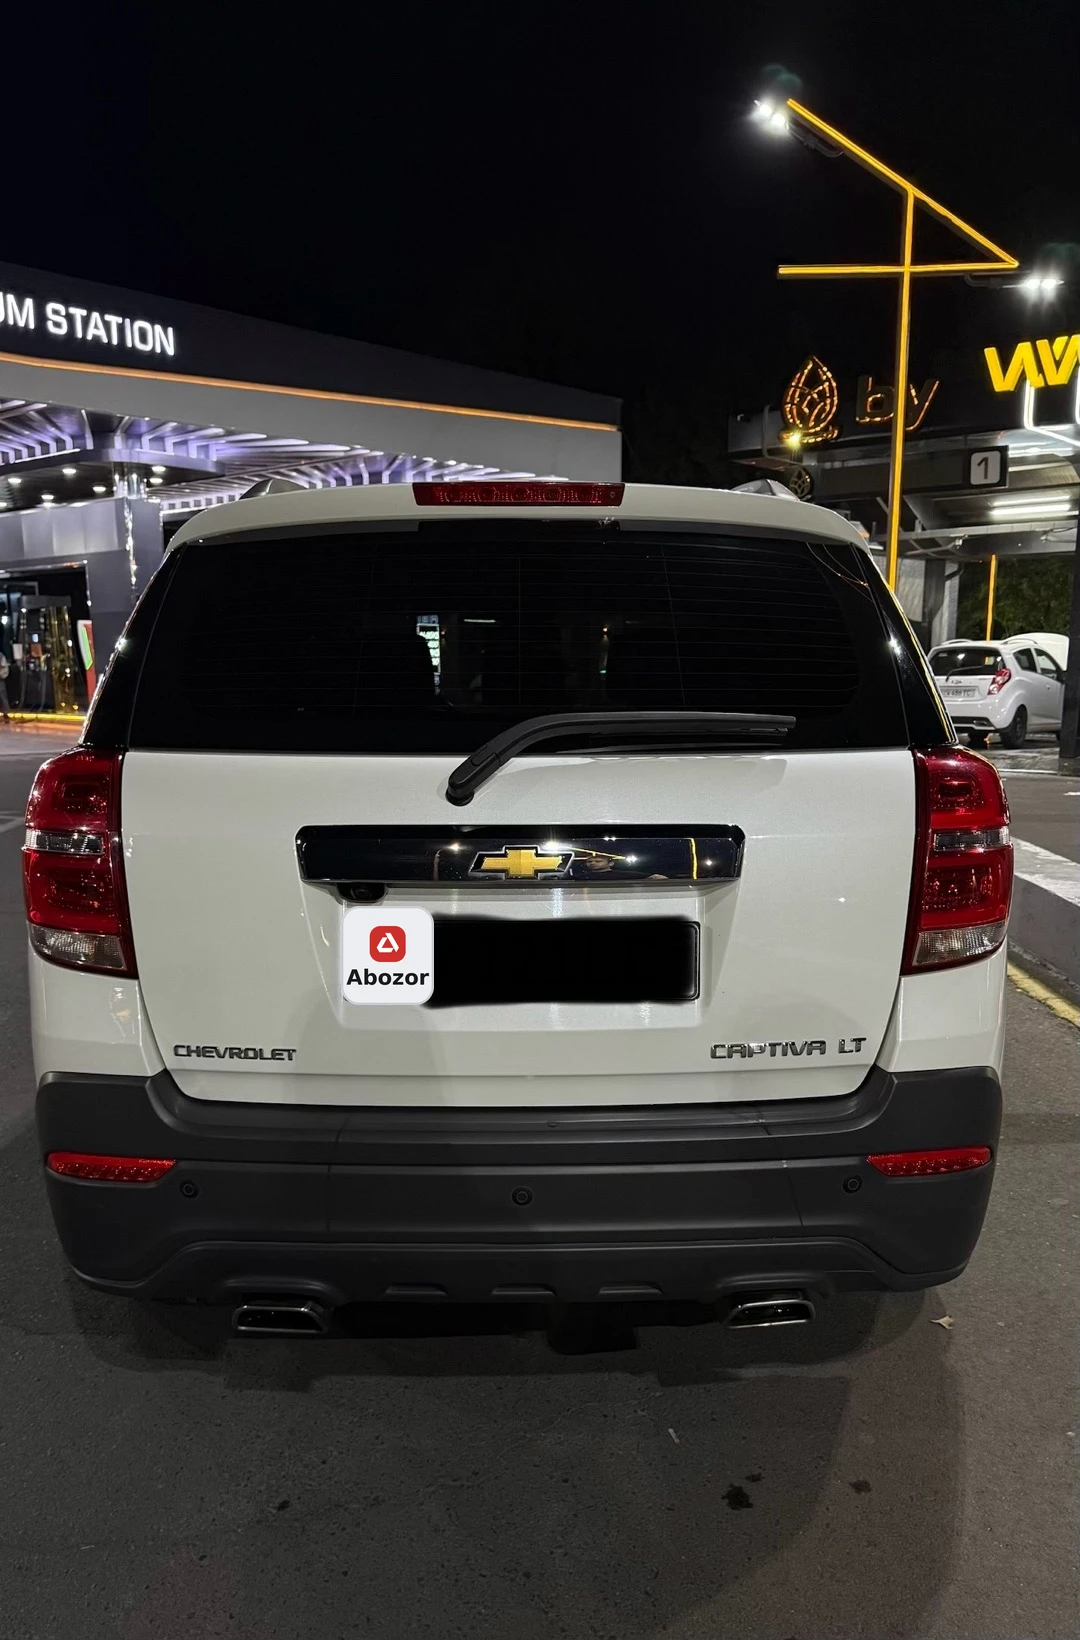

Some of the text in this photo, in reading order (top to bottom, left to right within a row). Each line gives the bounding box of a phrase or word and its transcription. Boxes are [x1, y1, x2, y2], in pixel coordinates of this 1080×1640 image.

[0, 291, 175, 356] M STATION
[856, 375, 940, 430] by
[976, 456, 989, 480] 1
[173, 1044, 297, 1061] CHEVROLET
[710, 1037, 867, 1059] CAPTIVA LT
